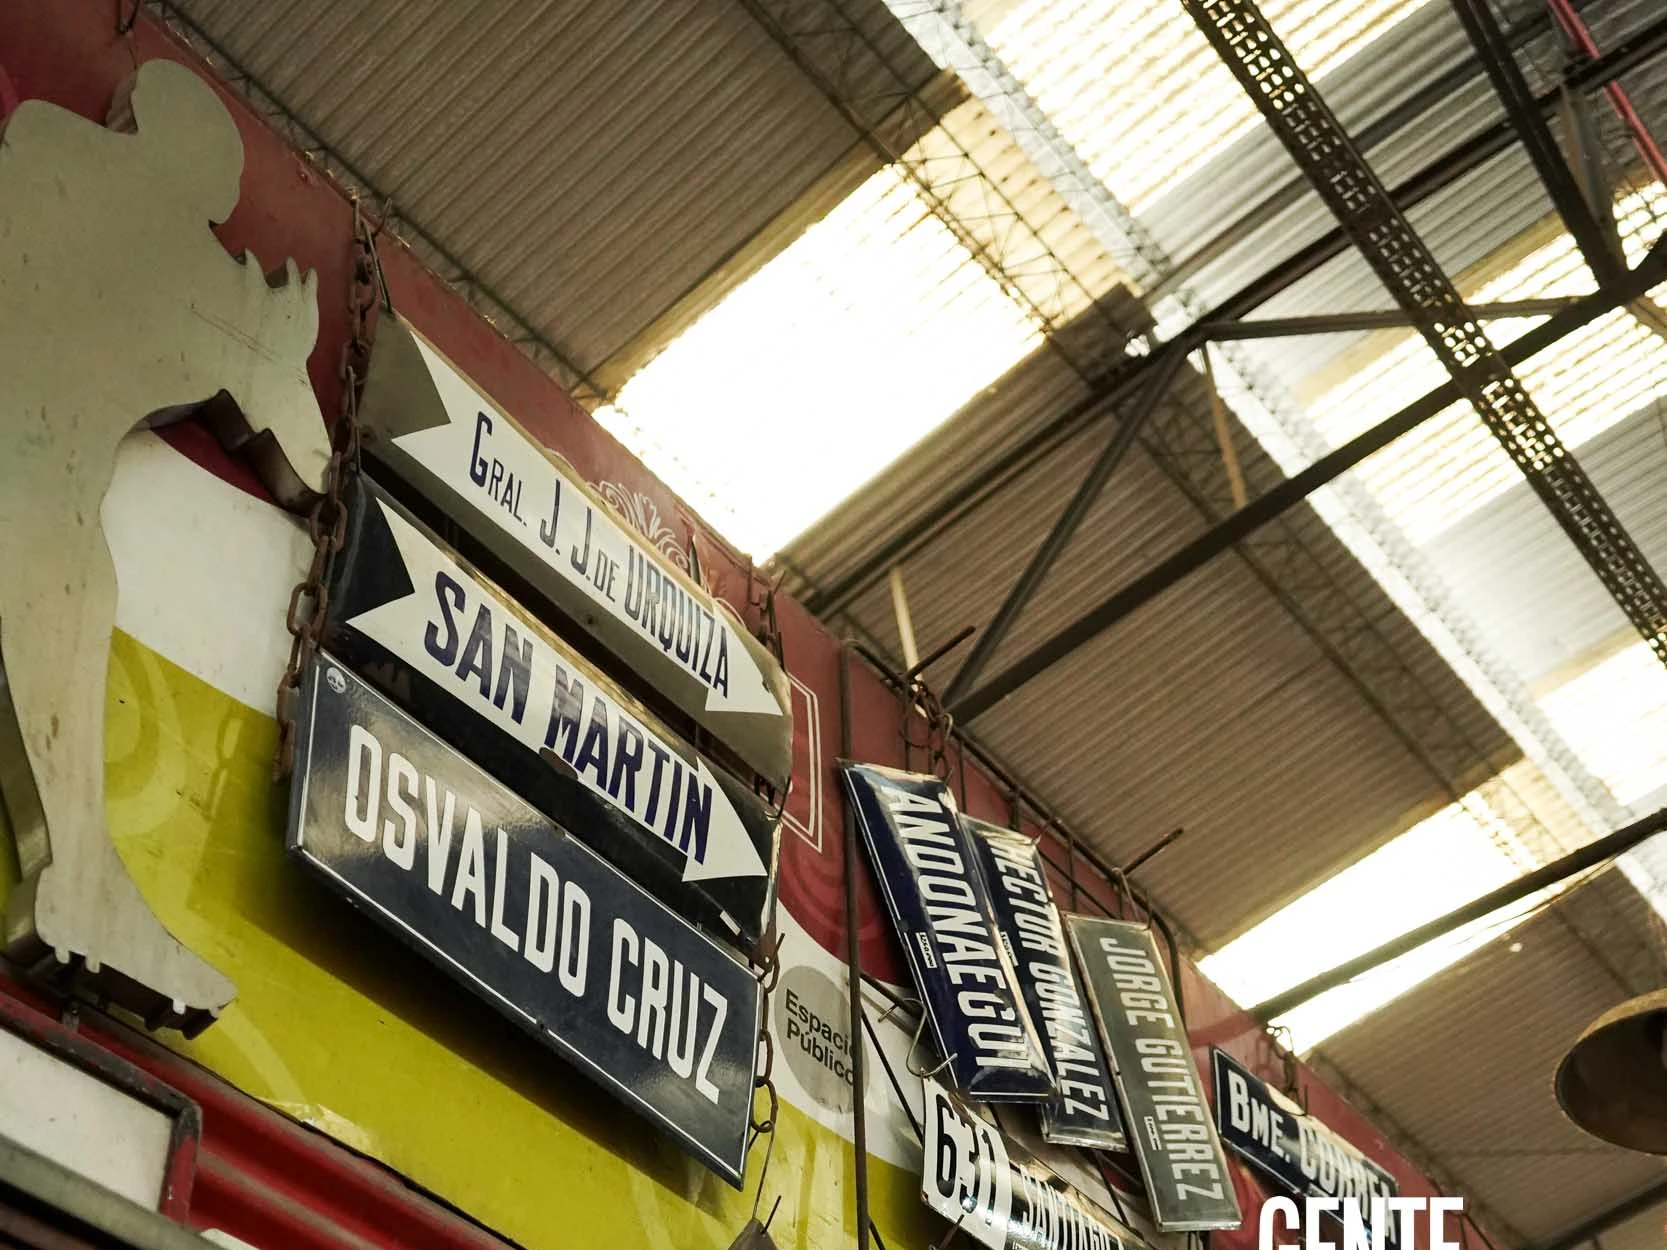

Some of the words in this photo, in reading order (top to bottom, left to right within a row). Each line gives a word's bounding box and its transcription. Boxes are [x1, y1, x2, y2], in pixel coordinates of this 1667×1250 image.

[540, 479, 561, 555] J.
[570, 507, 595, 580] J.
[595, 559, 617, 602] DE
[626, 545, 730, 699] URQUIZA
[425, 570, 533, 724] SAN
[545, 667, 713, 866] MARTIN
[344, 723, 591, 998] OSVALDO
[607, 916, 728, 1105] CRUZ
[785, 988, 851, 1051] Espaci
[887, 788, 1034, 1070] ANDONAEGUI
[986, 837, 1060, 957] HECTOR
[1029, 963, 1110, 1122] GONZALEZ
[1099, 936, 1173, 1028] JORGE
[1134, 1038, 1224, 1201] GUTIERREZ
